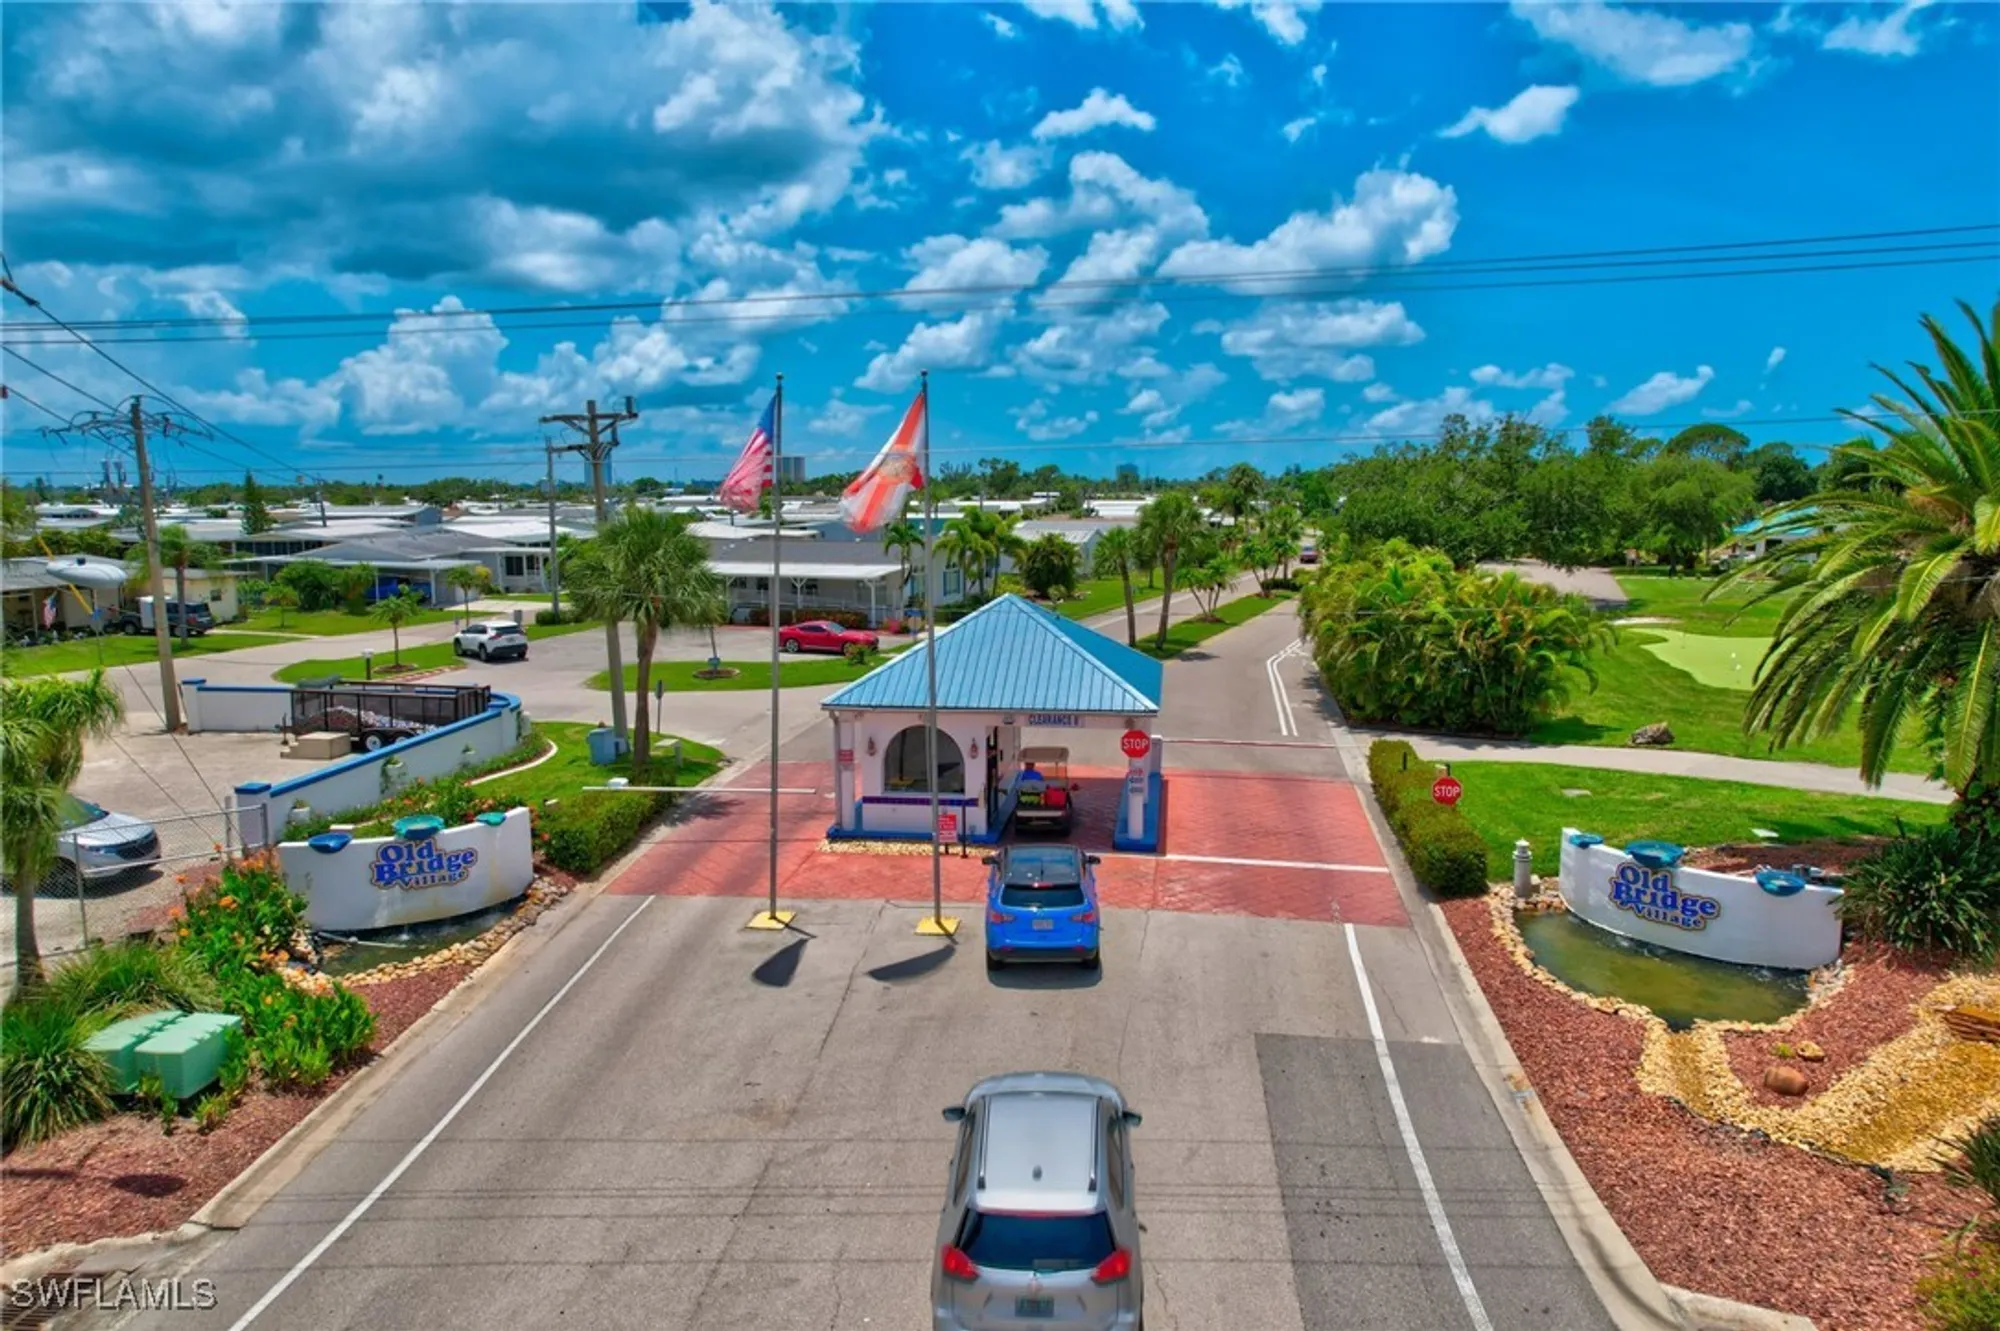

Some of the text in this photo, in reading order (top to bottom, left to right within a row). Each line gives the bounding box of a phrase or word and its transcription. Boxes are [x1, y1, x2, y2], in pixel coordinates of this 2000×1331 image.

[1123, 738, 1149, 750] STOP
[1434, 786, 1460, 798] STOP
[379, 839, 435, 863] Old
[374, 850, 475, 886] Bridge
[399, 871, 466, 887] Village
[1619, 865, 1669, 892] Old
[1613, 880, 1717, 918] Bridge
[1632, 902, 1702, 928] Village
